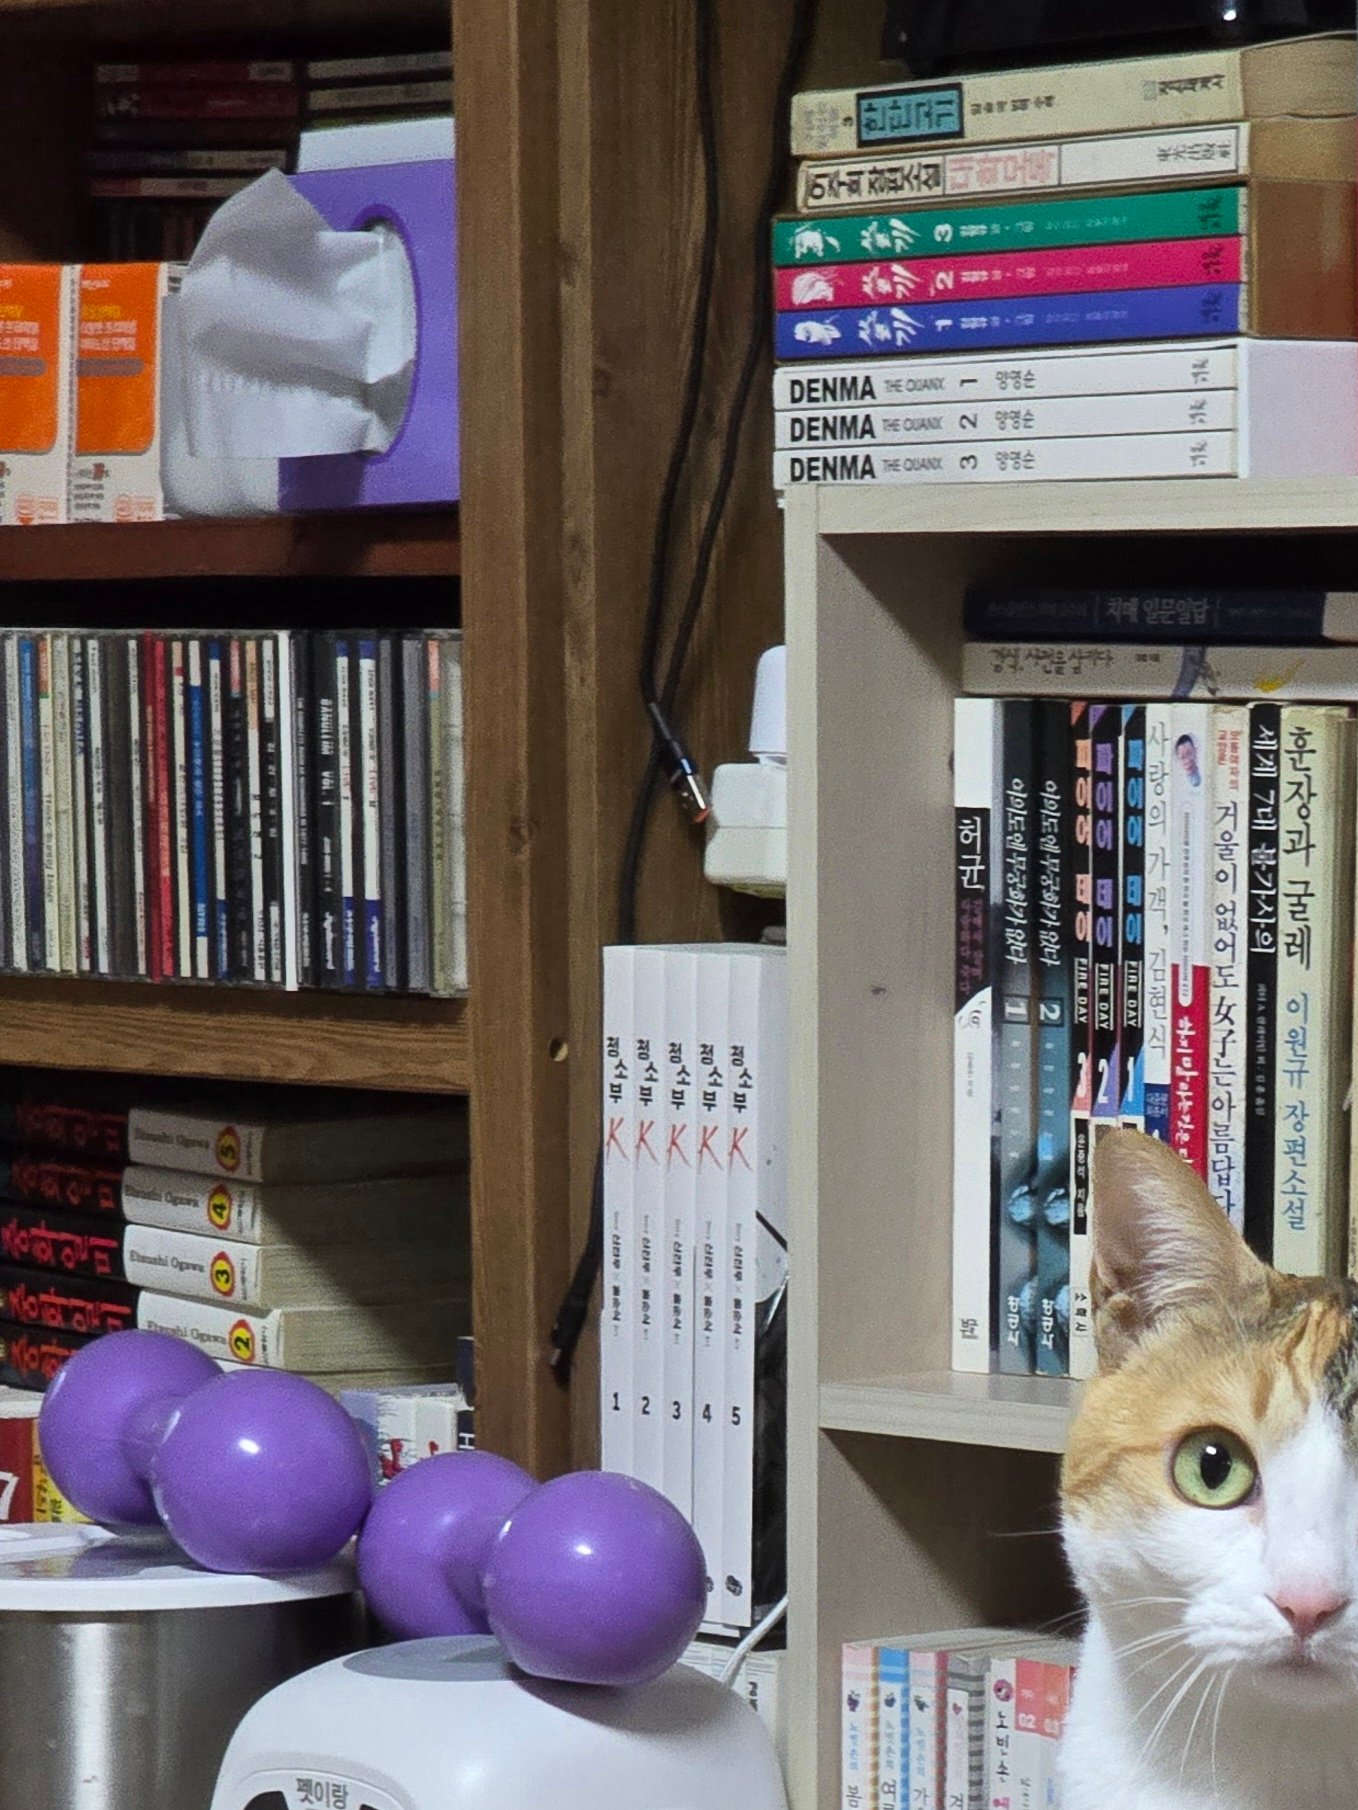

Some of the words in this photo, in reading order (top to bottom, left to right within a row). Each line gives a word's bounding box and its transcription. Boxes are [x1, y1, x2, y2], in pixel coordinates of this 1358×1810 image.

[933, 223, 953, 243] 3
[935, 270, 954, 289] 2
[790, 375, 876, 403] DENMA
[958, 378, 979, 389] 1
[790, 415, 876, 442] DENMA
[959, 413, 979, 430] 2
[790, 455, 876, 482] DENMA
[959, 454, 979, 469] 3
[1149, 721, 1170, 827] 사랑의
[1251, 725, 1277, 778] 세계
[1251, 791, 1277, 832] 7대
[1283, 727, 1318, 866] 훈장과
[1214, 802, 1240, 893] 거울이
[1149, 850, 1170, 936] 가객,
[1213, 903, 1239, 989] 없어도
[1283, 879, 1316, 971] 굴레
[1099, 964, 1110, 996] FIRE
[1126, 961, 1138, 993] FIRE
[1077, 996, 1088, 1023] DAY
[1099, 1002, 1110, 1030] DAY
[1126, 1000, 1138, 1027] DAY
[1149, 951, 1169, 1060] 김현식
[1284, 993, 1311, 1088] 이원규
[606, 1036, 628, 1104] 청소부
[636, 1038, 659, 1107] 청소부
[668, 1042, 691, 1111] 청소부
[699, 1044, 723, 1113] 청소부
[731, 1045, 754, 1114] 청소부
[606, 1117, 629, 1165] K
[635, 1119, 660, 1168] K
[667, 1123, 692, 1171] K
[698, 1125, 724, 1175] K
[728, 1127, 754, 1177] K
[1281, 1101, 1311, 1231] 장편소설
[612, 1391, 621, 1411] 1
[641, 1396, 651, 1416] 2
[672, 1401, 682, 1421] 3
[702, 1403, 712, 1424] 4
[732, 1406, 742, 1427] 5
